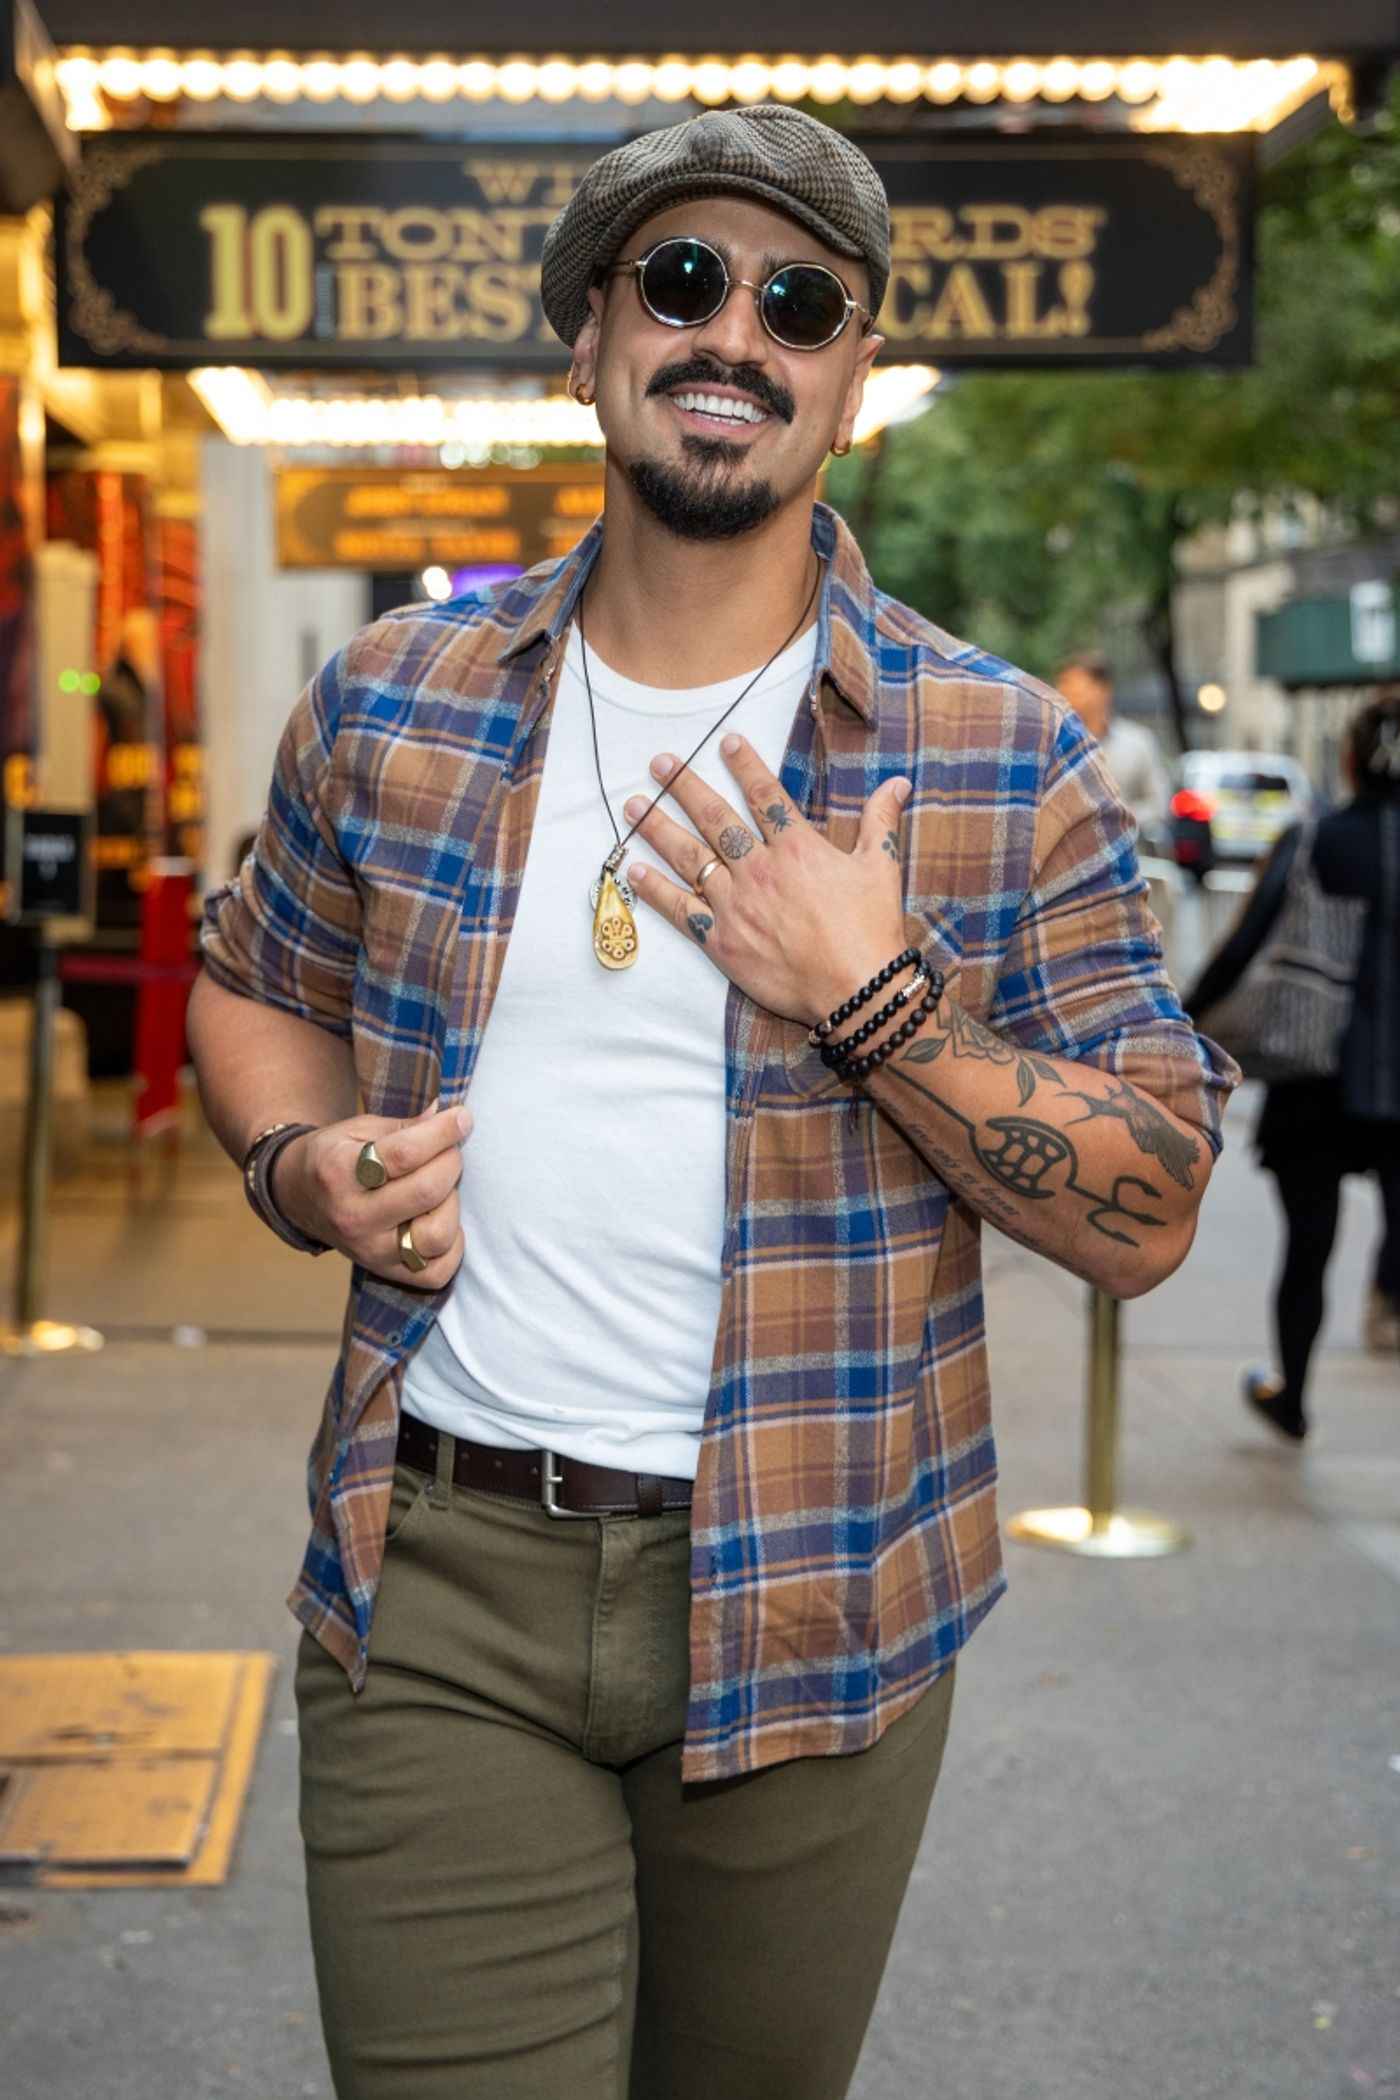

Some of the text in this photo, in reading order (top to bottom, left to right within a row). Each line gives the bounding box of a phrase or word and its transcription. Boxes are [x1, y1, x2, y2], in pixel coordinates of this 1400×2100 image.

[462, 160, 594, 204] WI
[200, 203, 315, 341] 10
[886, 203, 1108, 261] RDS
[874, 260, 1095, 340] CAL!
